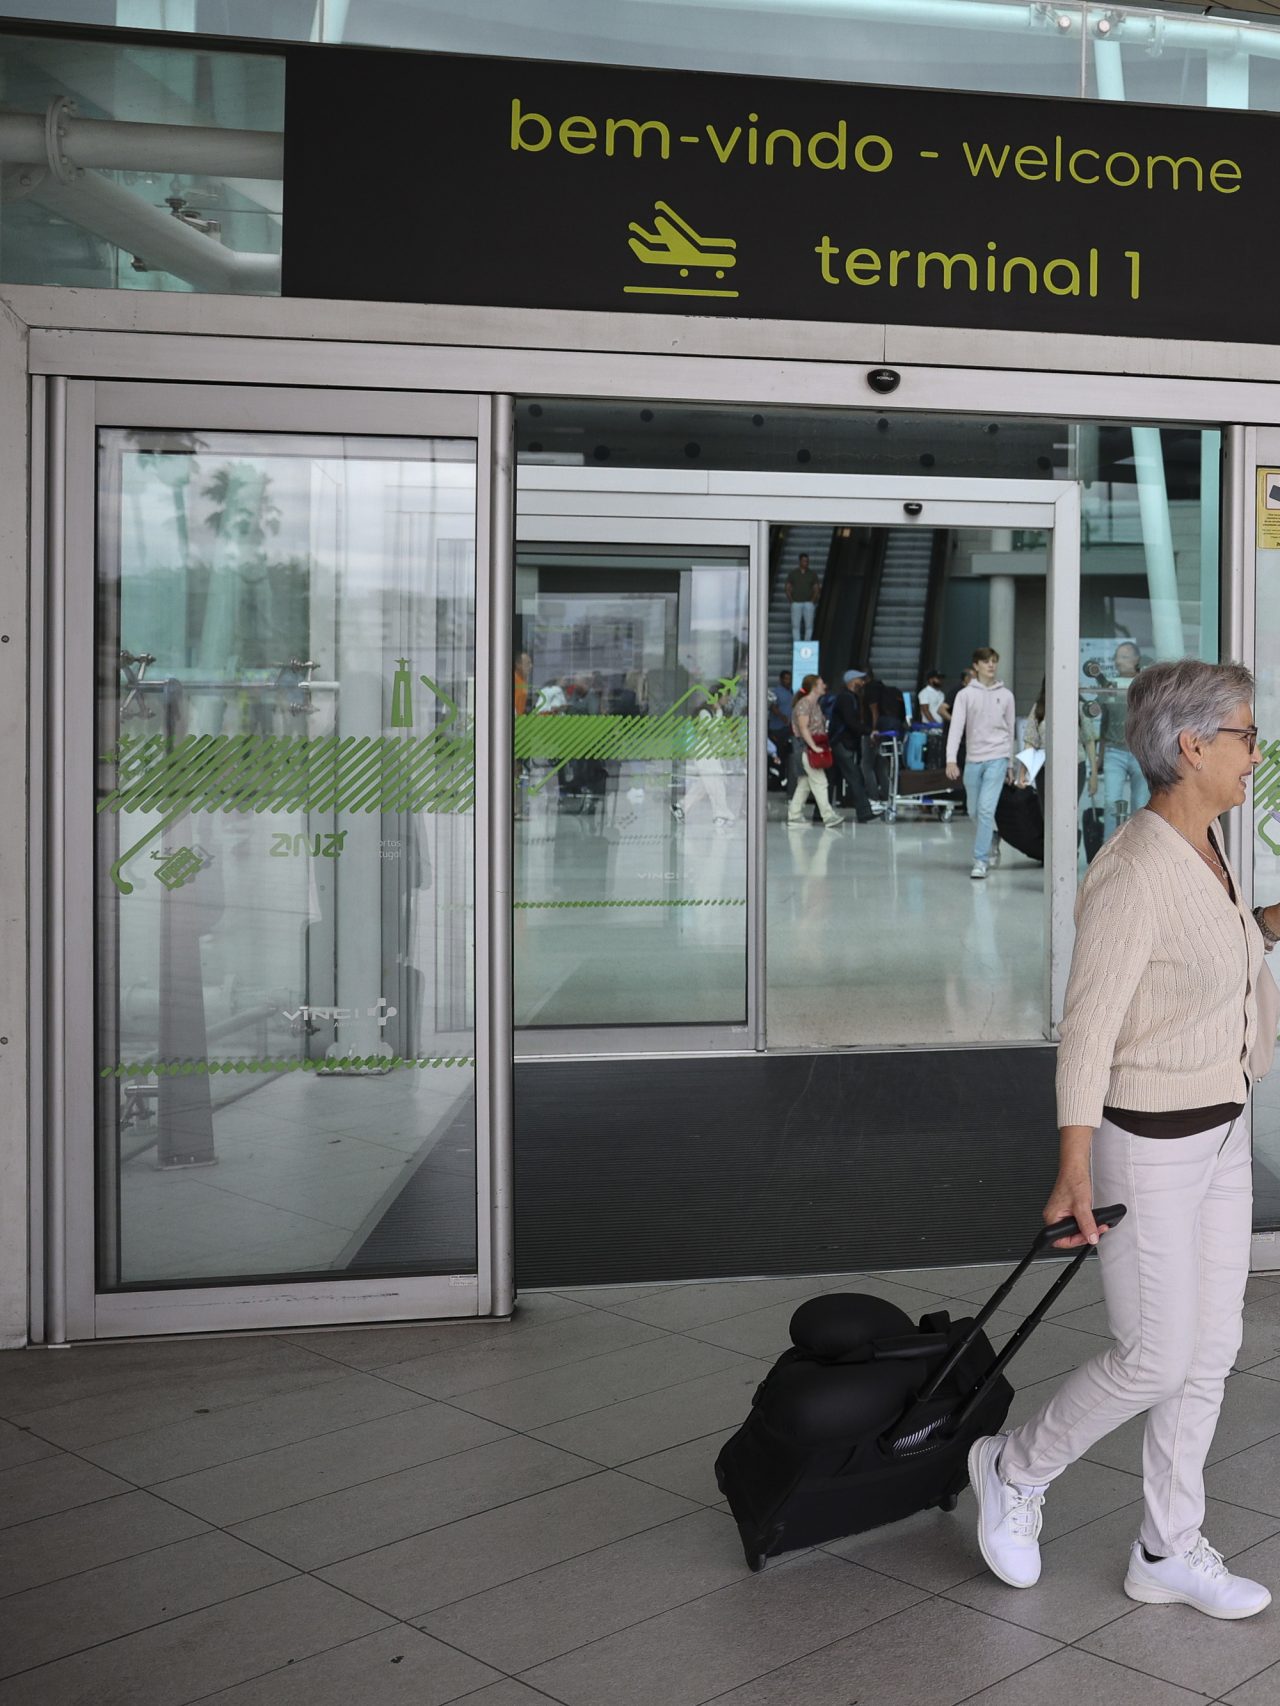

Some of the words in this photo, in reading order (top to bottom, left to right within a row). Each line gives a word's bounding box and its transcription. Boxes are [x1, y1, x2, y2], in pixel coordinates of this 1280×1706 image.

[510, 98, 894, 173] bem-vindo
[962, 135, 1242, 194] welcome
[815, 235, 1099, 298] terminal
[1124, 250, 1141, 300] 1
[282, 1006, 360, 1021] VINCI
